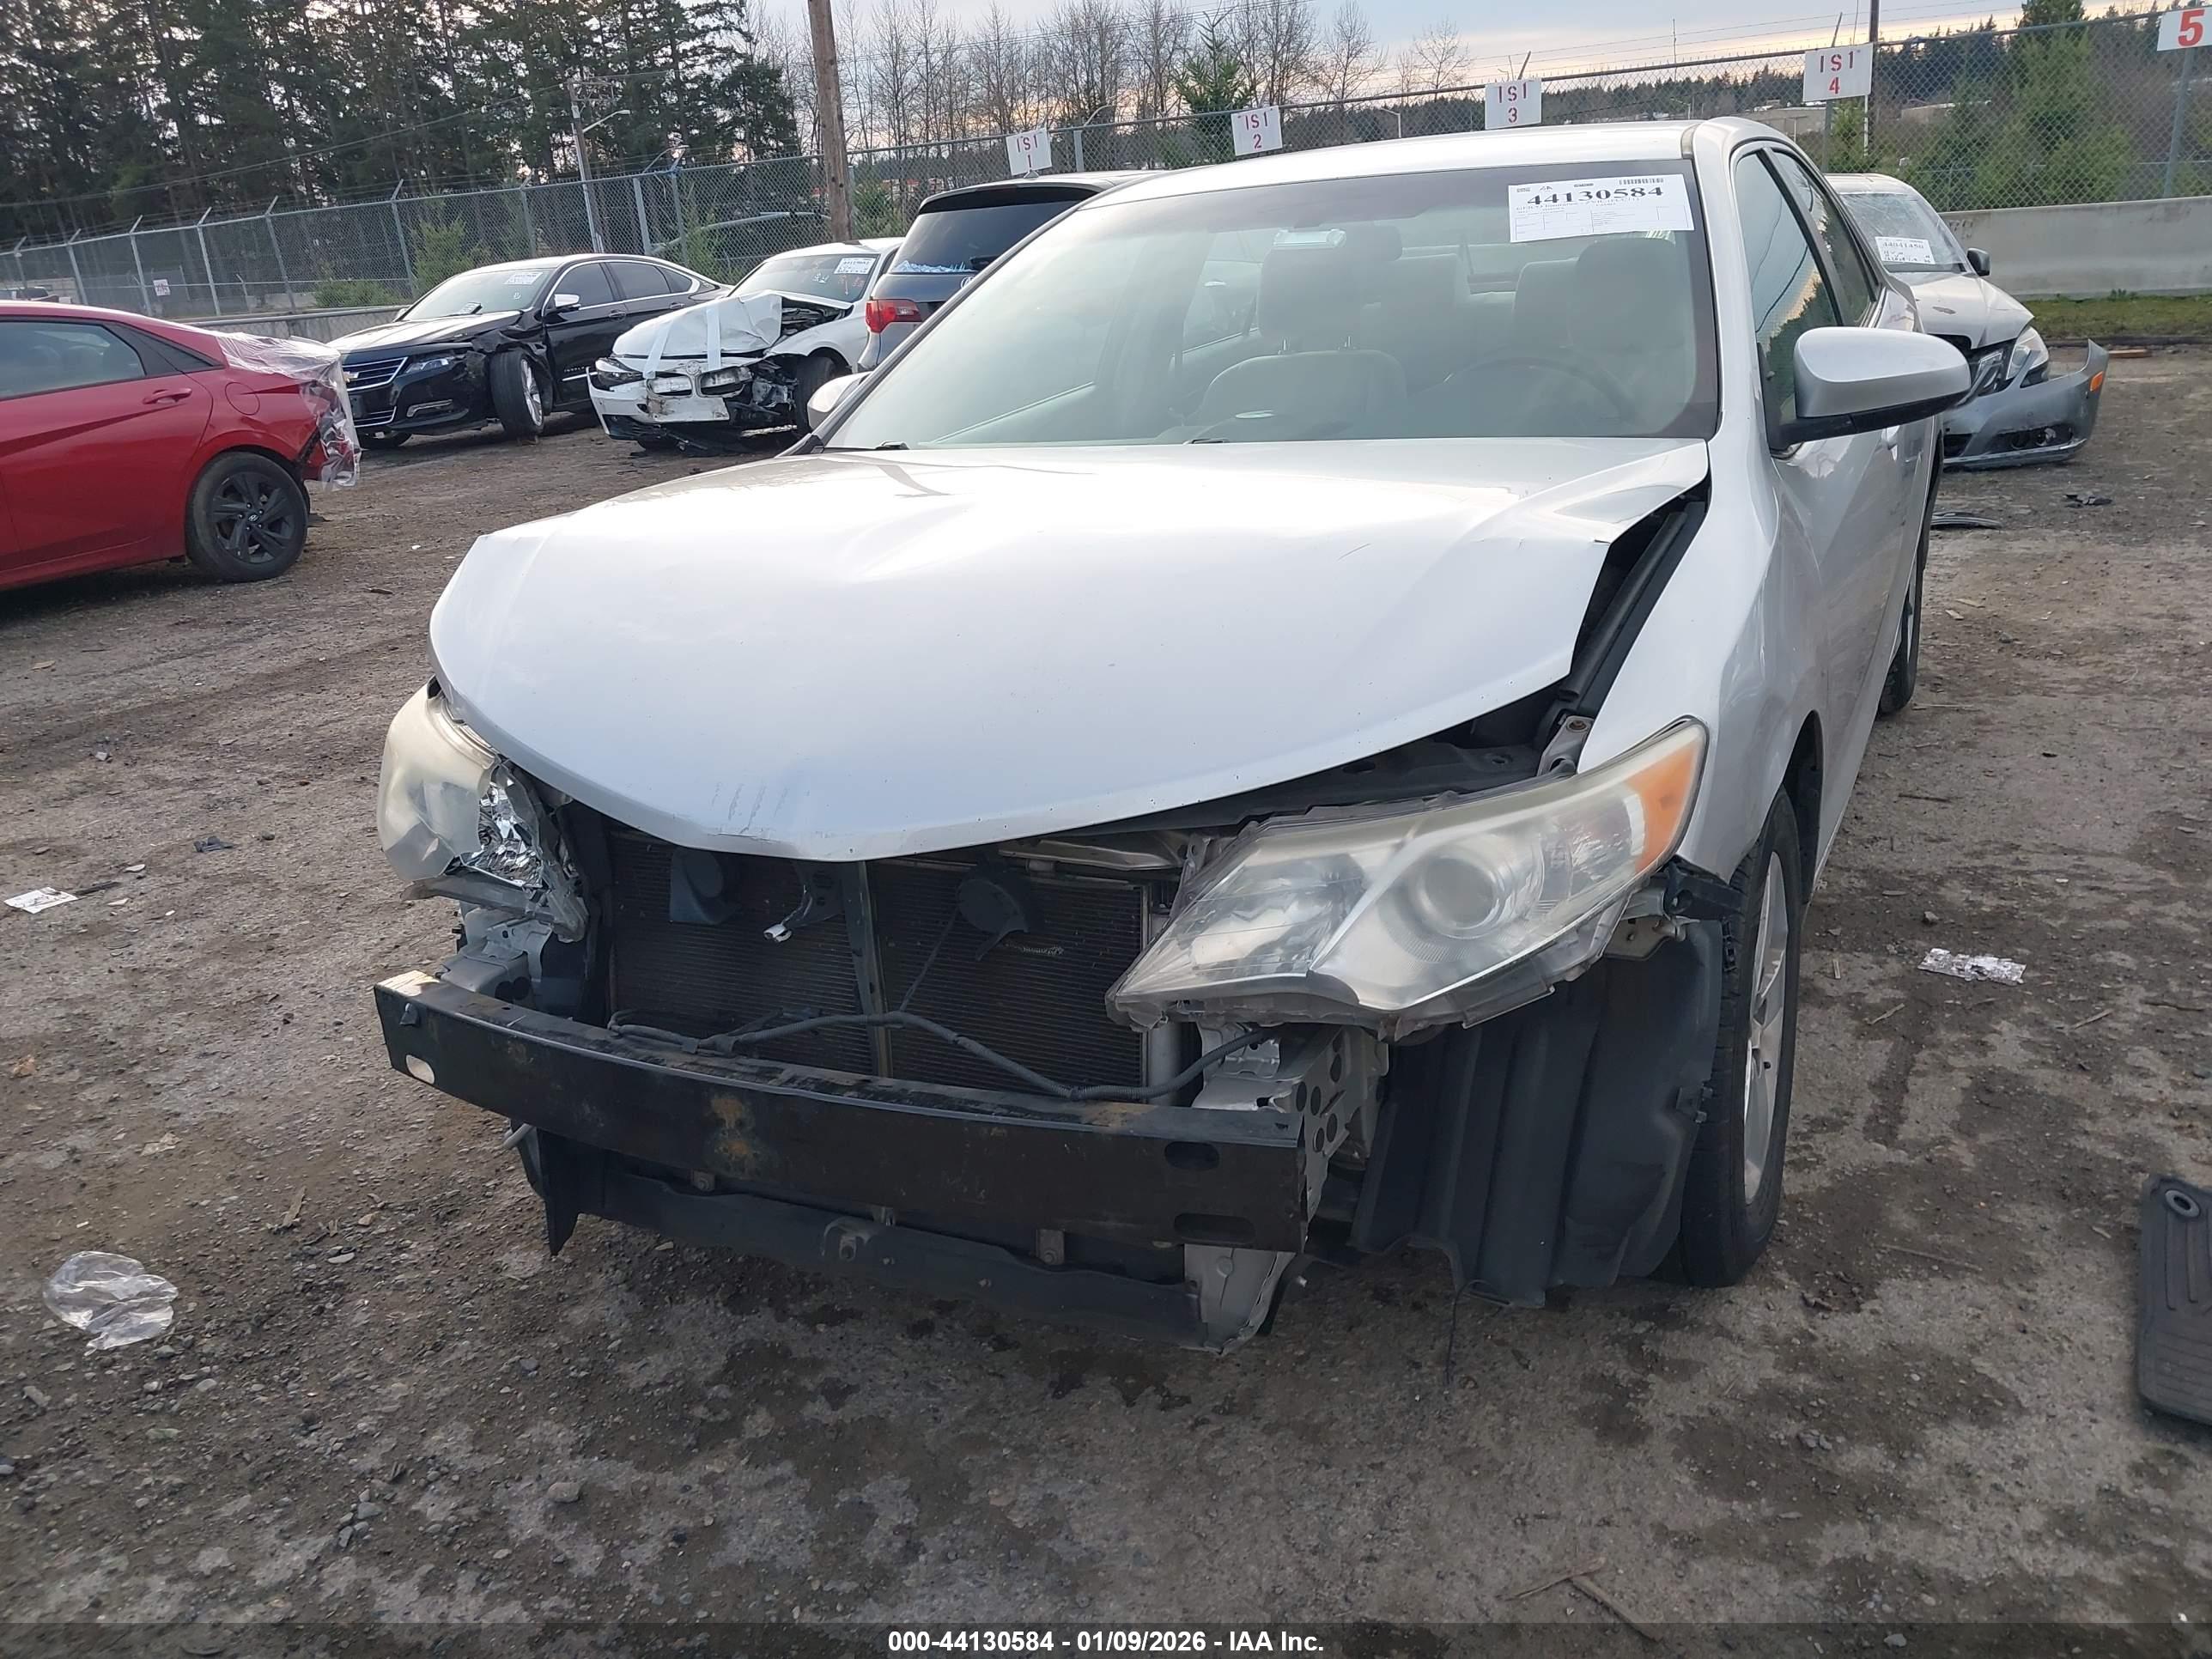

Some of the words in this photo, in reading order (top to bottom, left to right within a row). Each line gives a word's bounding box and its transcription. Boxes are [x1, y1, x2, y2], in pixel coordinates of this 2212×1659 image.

[2178, 9, 2205, 46] 5
[1828, 76, 1840, 94] 4
[1508, 107, 1517, 123] 3
[1253, 133, 1262, 149] 2
[1528, 186, 1664, 205] 44130584
